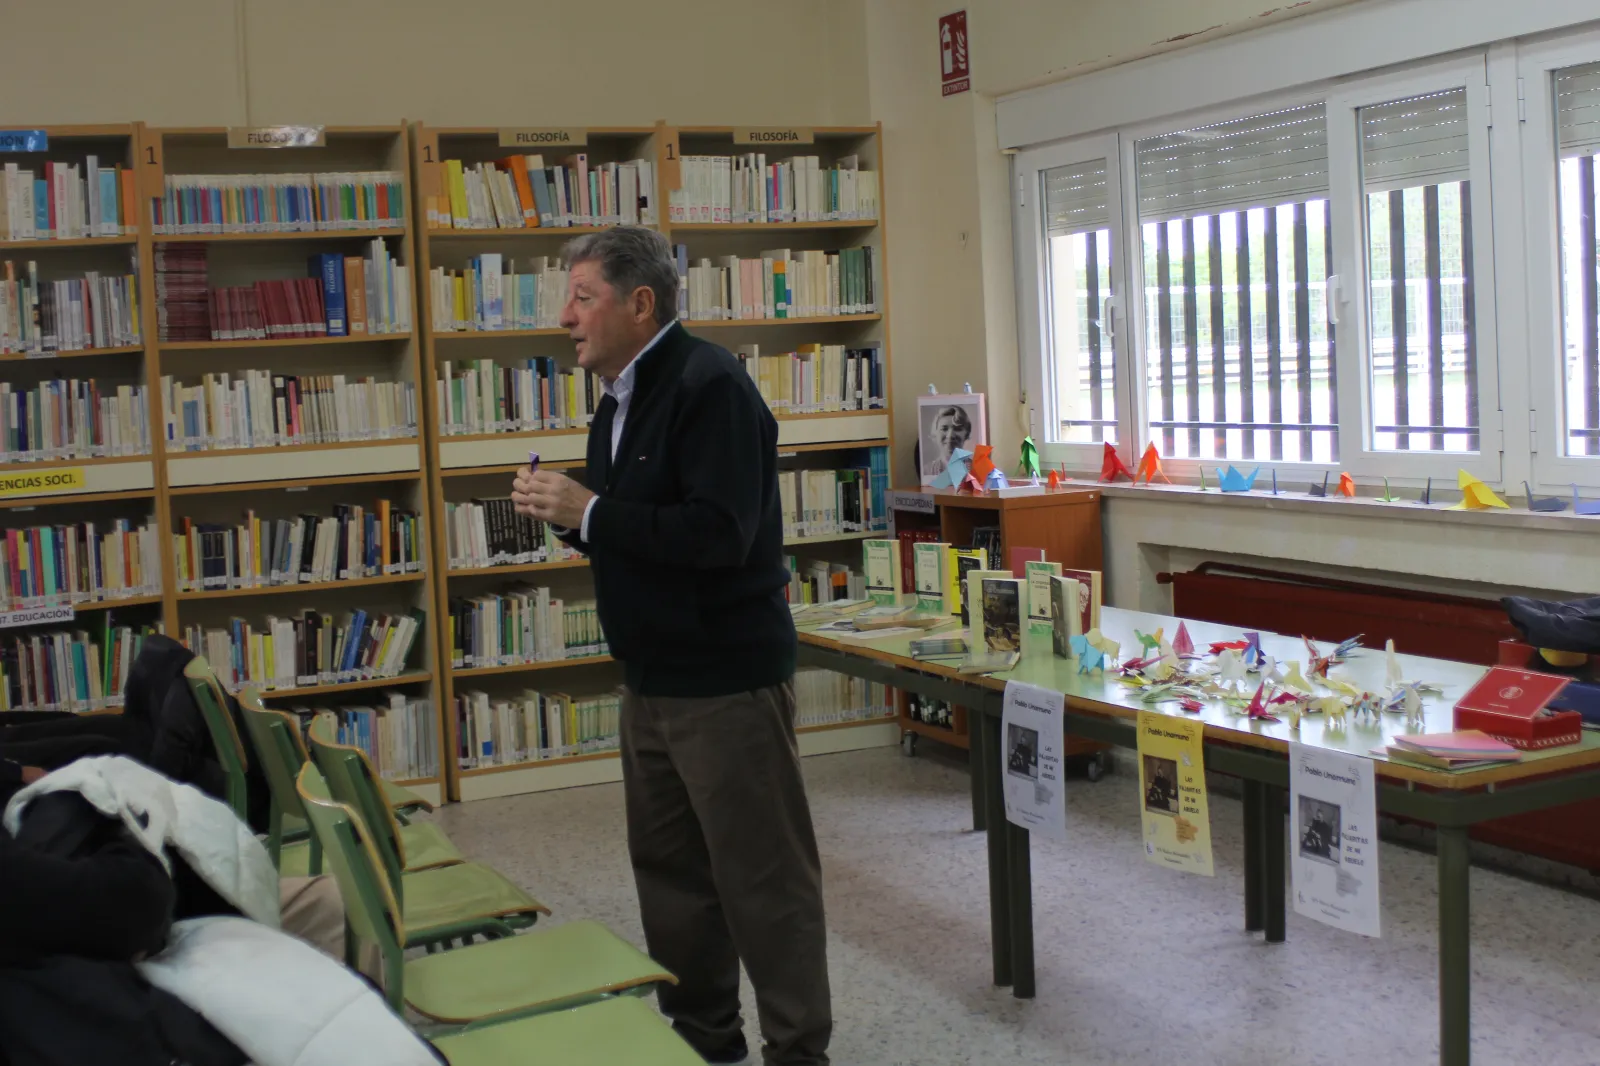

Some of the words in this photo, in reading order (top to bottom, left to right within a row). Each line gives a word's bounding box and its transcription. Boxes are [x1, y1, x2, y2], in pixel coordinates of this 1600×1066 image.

[516, 130, 570, 143] FILOSOFÍA
[750, 129, 799, 141] FILOSOFÍA
[146, 146, 158, 165] 1
[423, 145, 434, 163] 1
[665, 143, 676, 160] 1
[44, 473, 77, 486] SOCI.
[1014, 699, 1028, 709] Pablo
[1028, 703, 1052, 715] Unamuno
[1147, 727, 1163, 737] Pablo
[1163, 730, 1190, 742] Unamuno
[1304, 765, 1322, 777] Pablo
[1323, 771, 1356, 786] Unamuno
